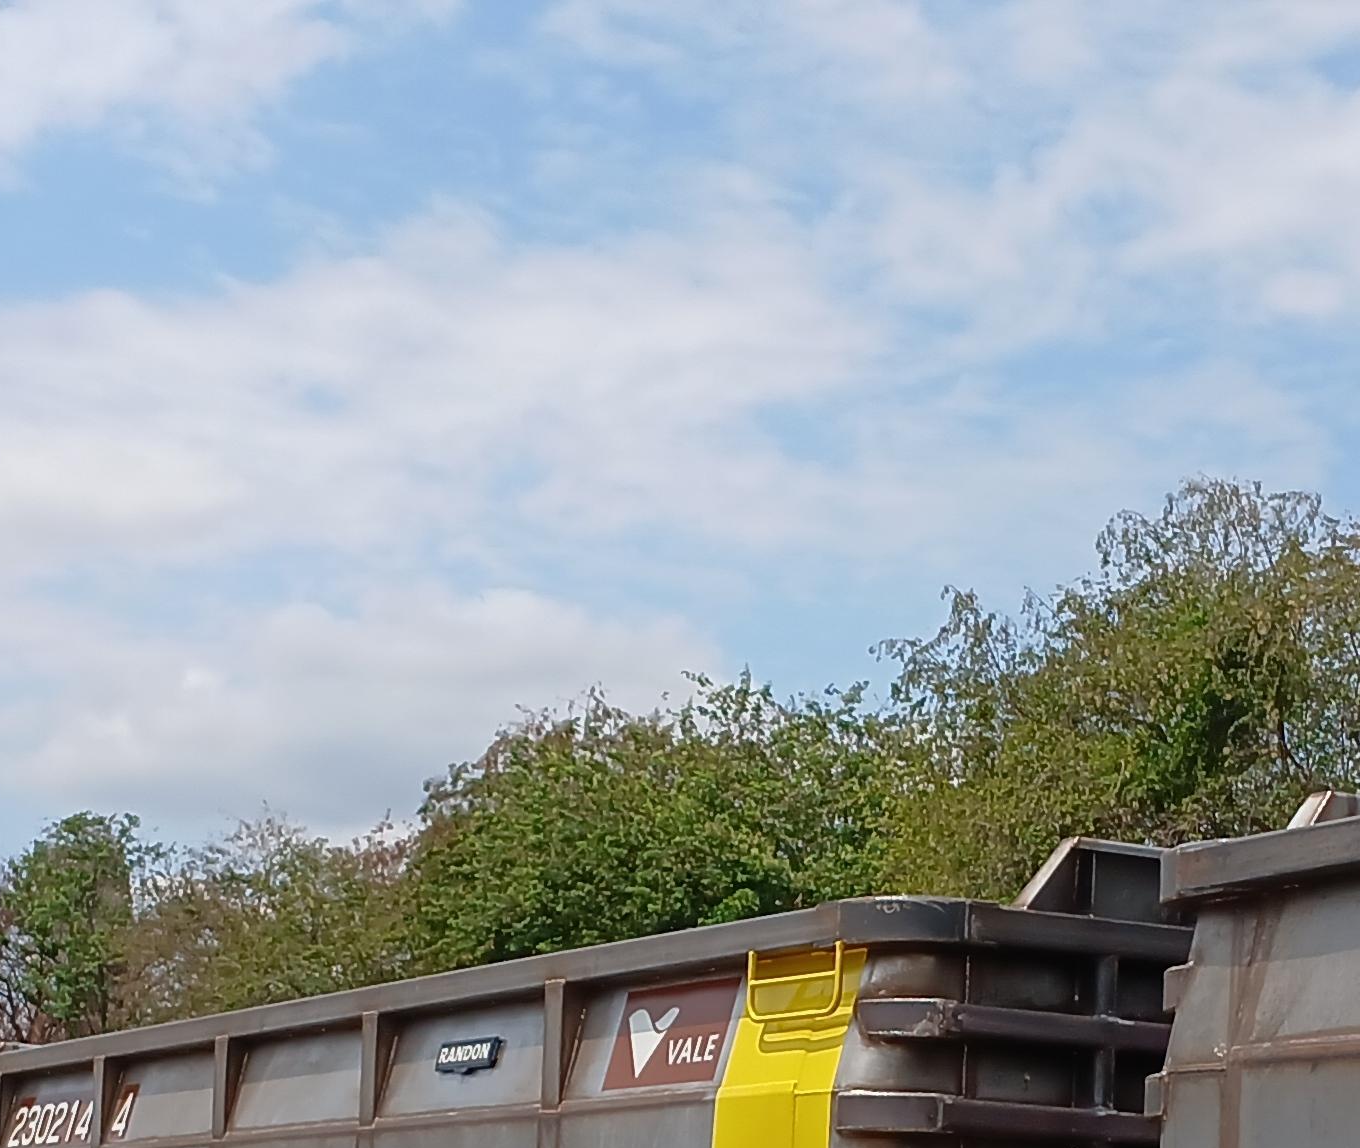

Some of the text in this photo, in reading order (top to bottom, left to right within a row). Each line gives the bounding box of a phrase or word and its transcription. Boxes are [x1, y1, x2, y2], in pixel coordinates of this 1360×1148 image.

[438, 1042, 492, 1065] RANDON
[667, 1033, 720, 1065] VALE
[7, 1099, 94, 1148] 230214
[111, 1092, 134, 1137] 4
